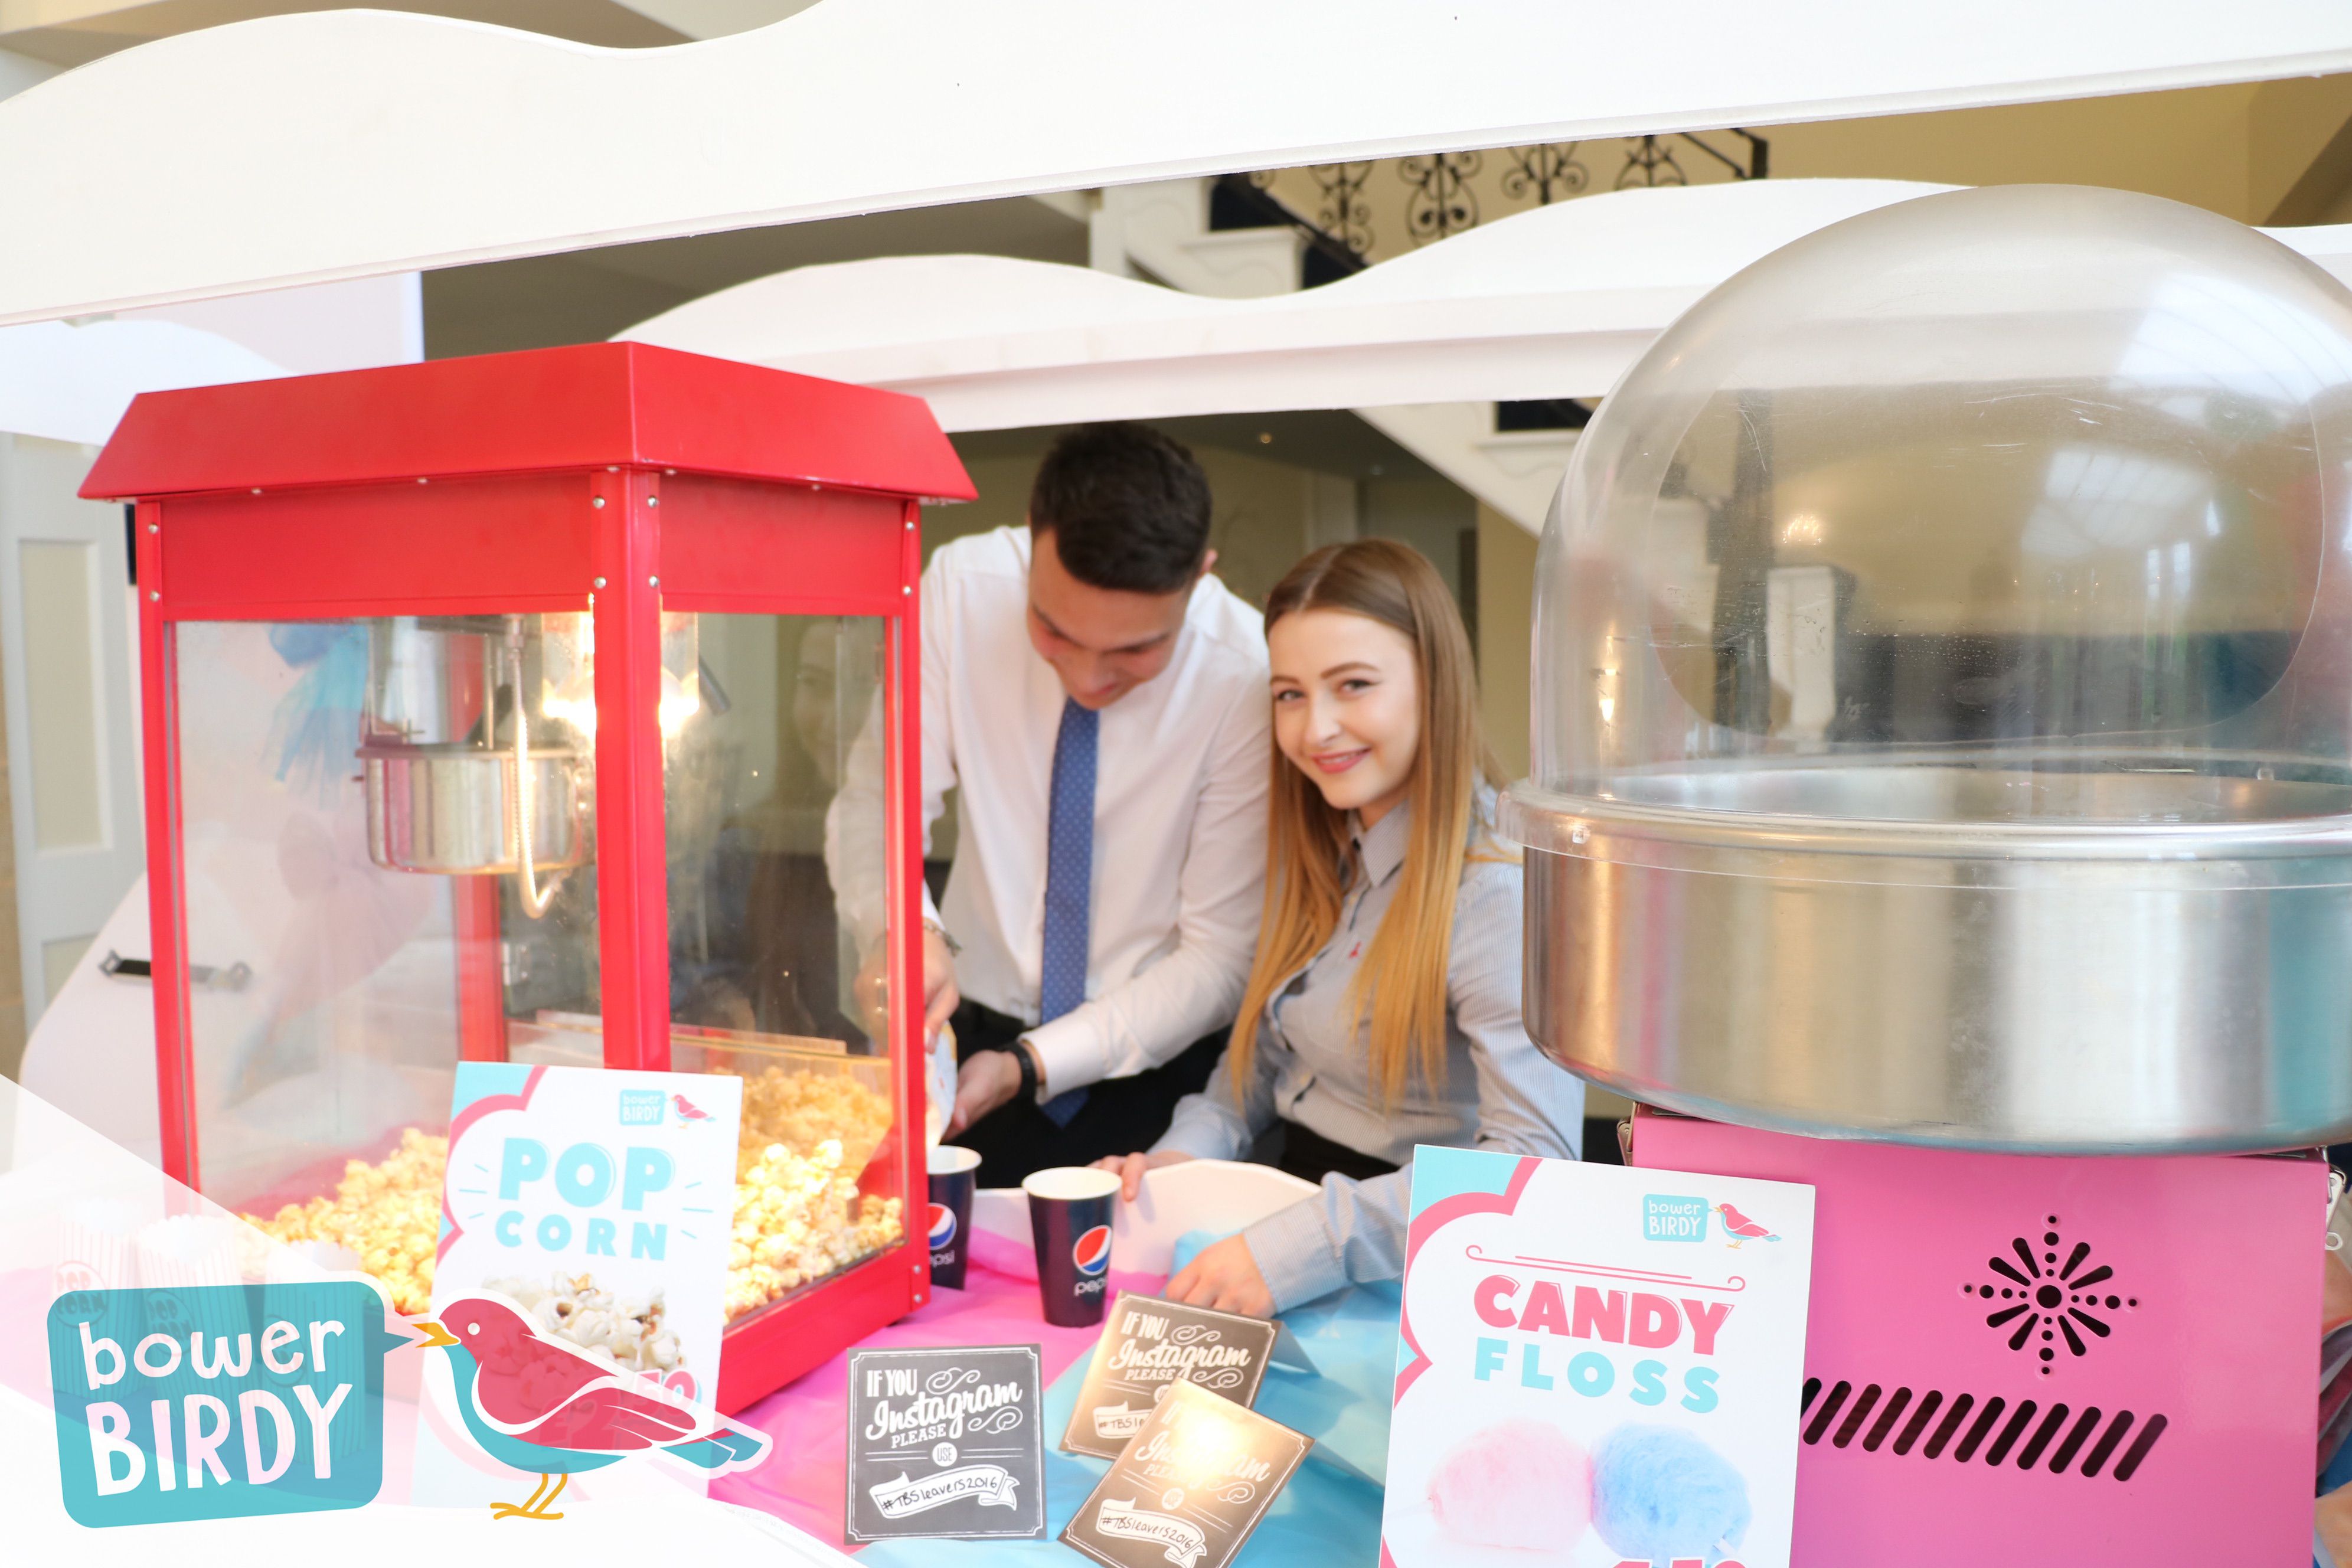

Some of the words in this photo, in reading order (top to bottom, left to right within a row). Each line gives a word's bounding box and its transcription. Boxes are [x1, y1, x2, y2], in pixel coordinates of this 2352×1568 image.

[623, 1094, 660, 1105] bower
[623, 1105, 661, 1122] BIRDY
[498, 1138, 674, 1211] POP
[1649, 1200, 1701, 1215] bower
[495, 1210, 668, 1261] CORN
[1649, 1216, 1701, 1236] BIRDY
[929, 1250, 955, 1268] psi
[1121, 1311, 1141, 1336] IF
[1138, 1315, 1170, 1341] YOU
[1474, 1274, 1734, 1355] CANDY
[1108, 1338, 1252, 1379] Instagram
[867, 1370, 883, 1397] IF
[886, 1369, 917, 1396] YOU
[1124, 1368, 1176, 1381] PLEASE
[1474, 1337, 1720, 1413] FLOSS
[865, 1381, 1023, 1440] Instagram
[891, 1424, 946, 1448] PLEASE
[937, 1447, 952, 1462] USE
